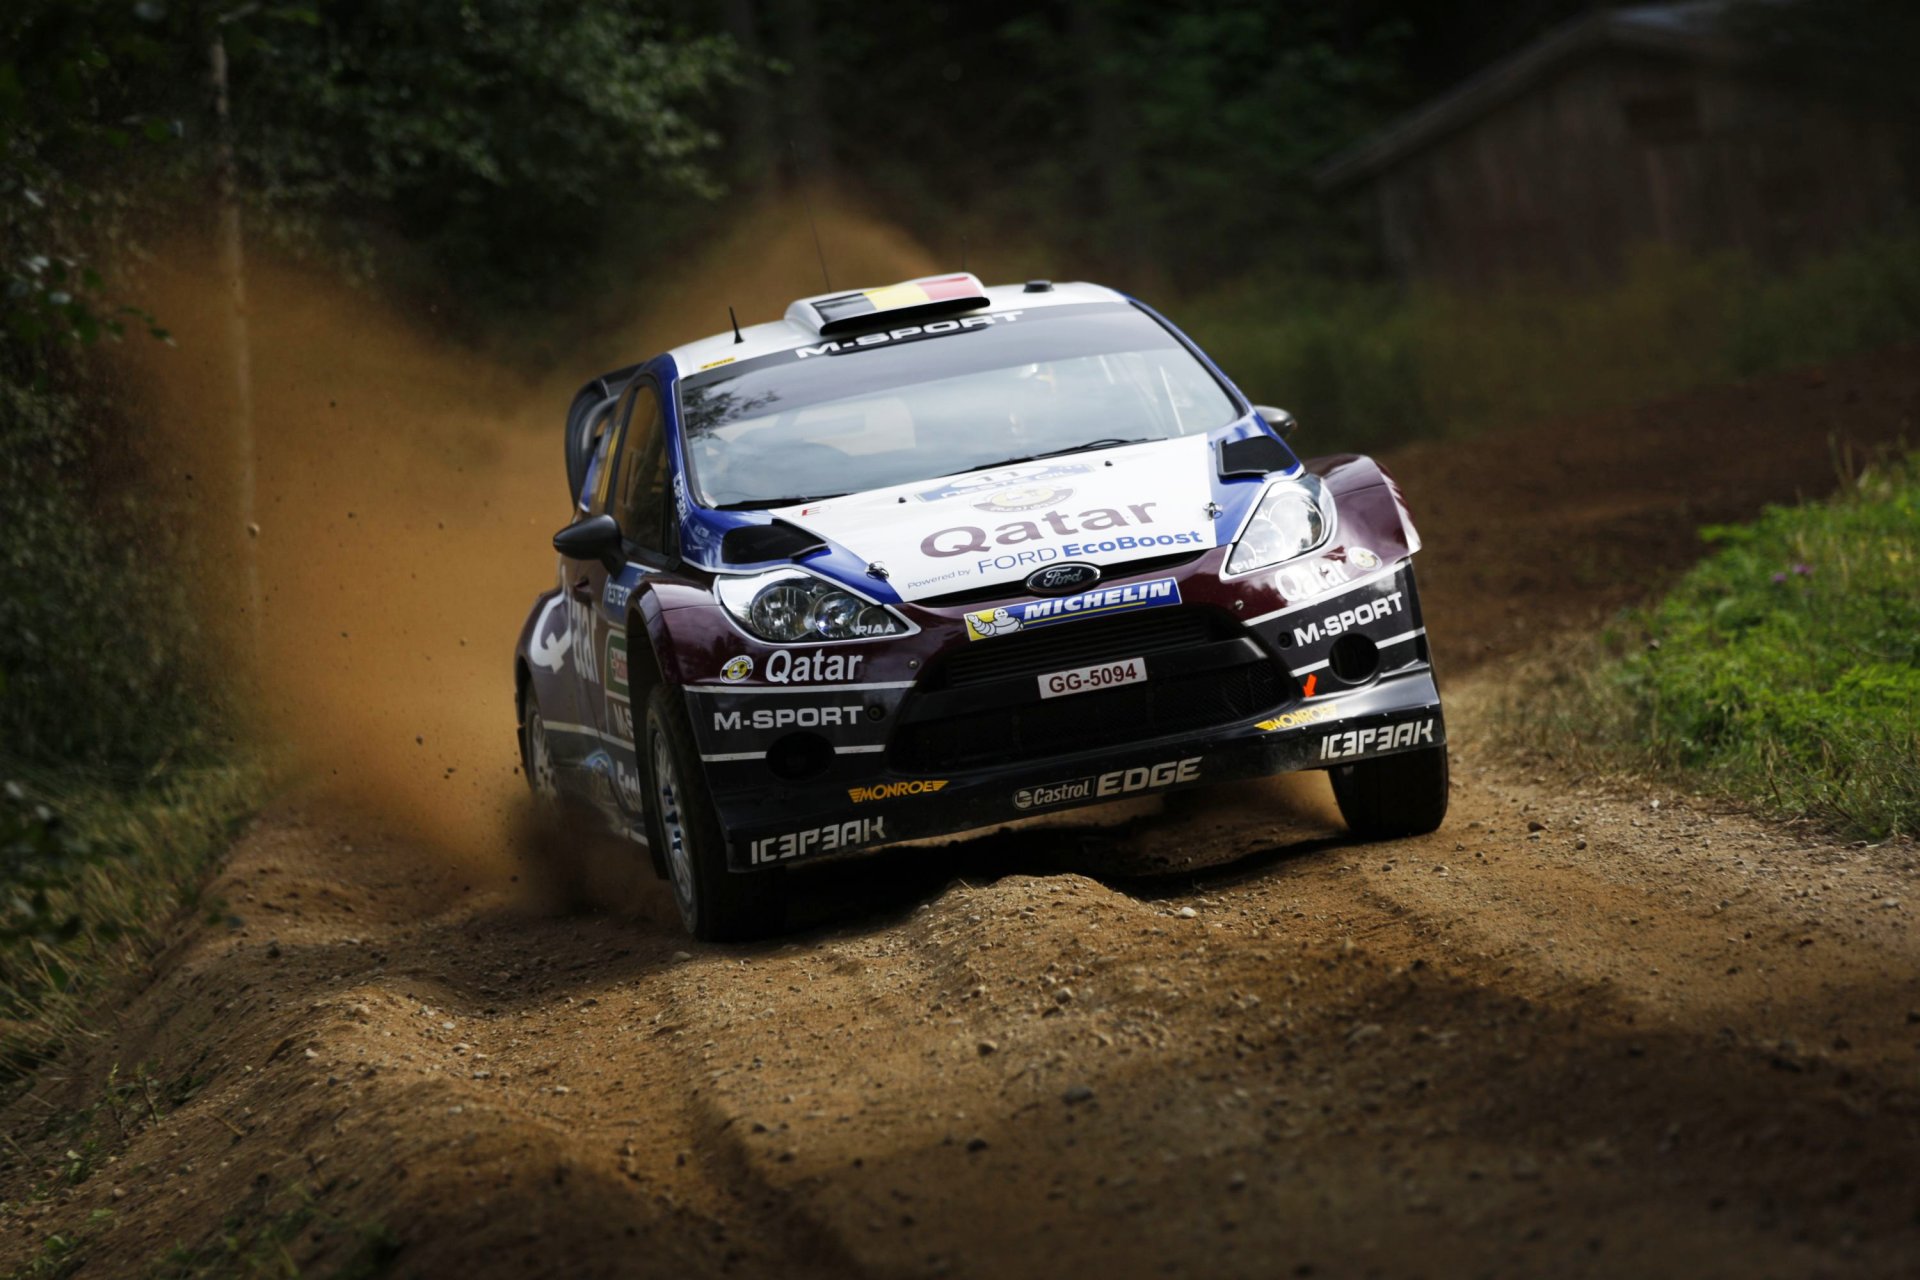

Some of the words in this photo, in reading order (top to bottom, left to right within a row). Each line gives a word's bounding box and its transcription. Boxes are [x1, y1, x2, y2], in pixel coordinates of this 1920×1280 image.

[795, 311, 1023, 359] M-SPORT
[920, 502, 1157, 558] Qatar
[907, 572, 956, 589] Powered
[957, 567, 971, 580] by
[977, 548, 1057, 574] FORD
[1062, 530, 1203, 557] EcoBoost
[1043, 567, 1083, 588] Ford
[1023, 582, 1172, 620] MICHELIN
[1293, 592, 1403, 647] M-SPORT
[766, 649, 863, 684] Qatar
[1049, 663, 1137, 693] GG-5094
[714, 706, 863, 731] M-SPORT
[860, 781, 934, 801] MONROE
[1033, 780, 1090, 805] Castrol
[1097, 756, 1203, 797] EDGE
